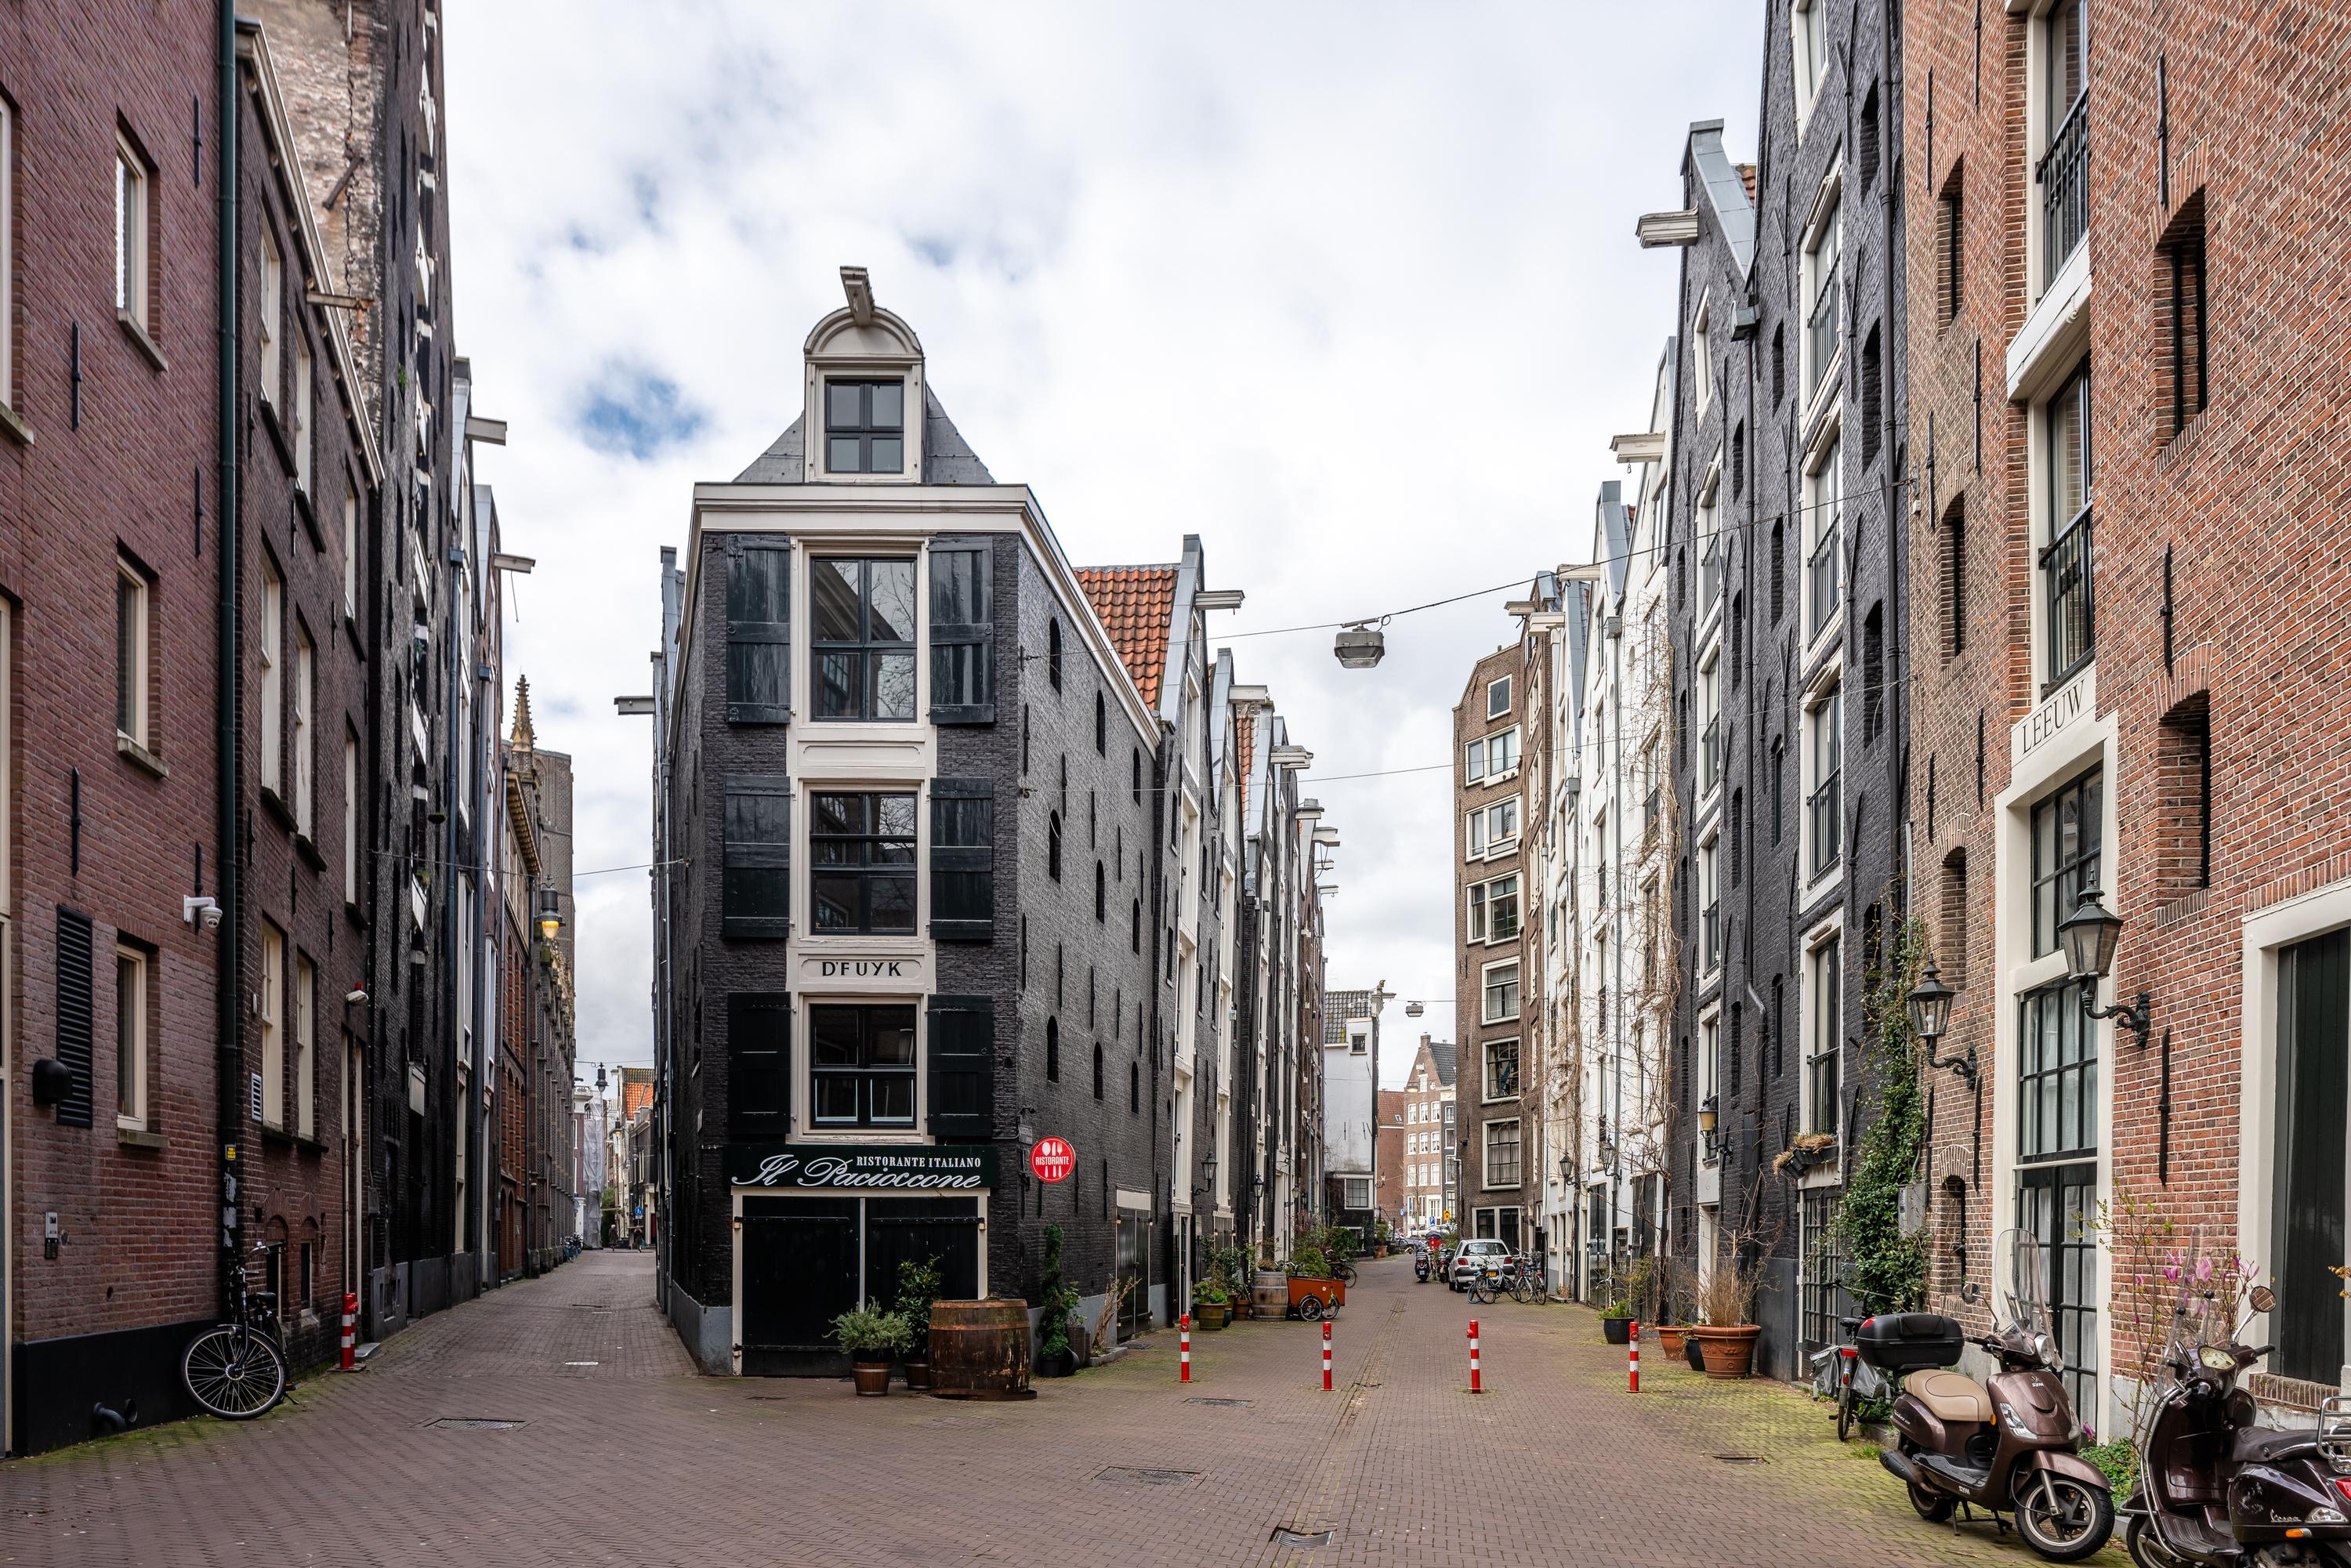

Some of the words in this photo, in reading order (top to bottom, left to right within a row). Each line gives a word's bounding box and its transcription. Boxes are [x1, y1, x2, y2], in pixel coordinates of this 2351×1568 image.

[2022, 679, 2085, 755] LEEUW
[731, 1154, 799, 1186] Il
[797, 1157, 981, 1188] Pacioccone
[857, 1156, 926, 1167] RISTORANTE
[929, 1157, 981, 1168] ITALIANO
[1035, 1156, 1070, 1165] RISTORANTE
